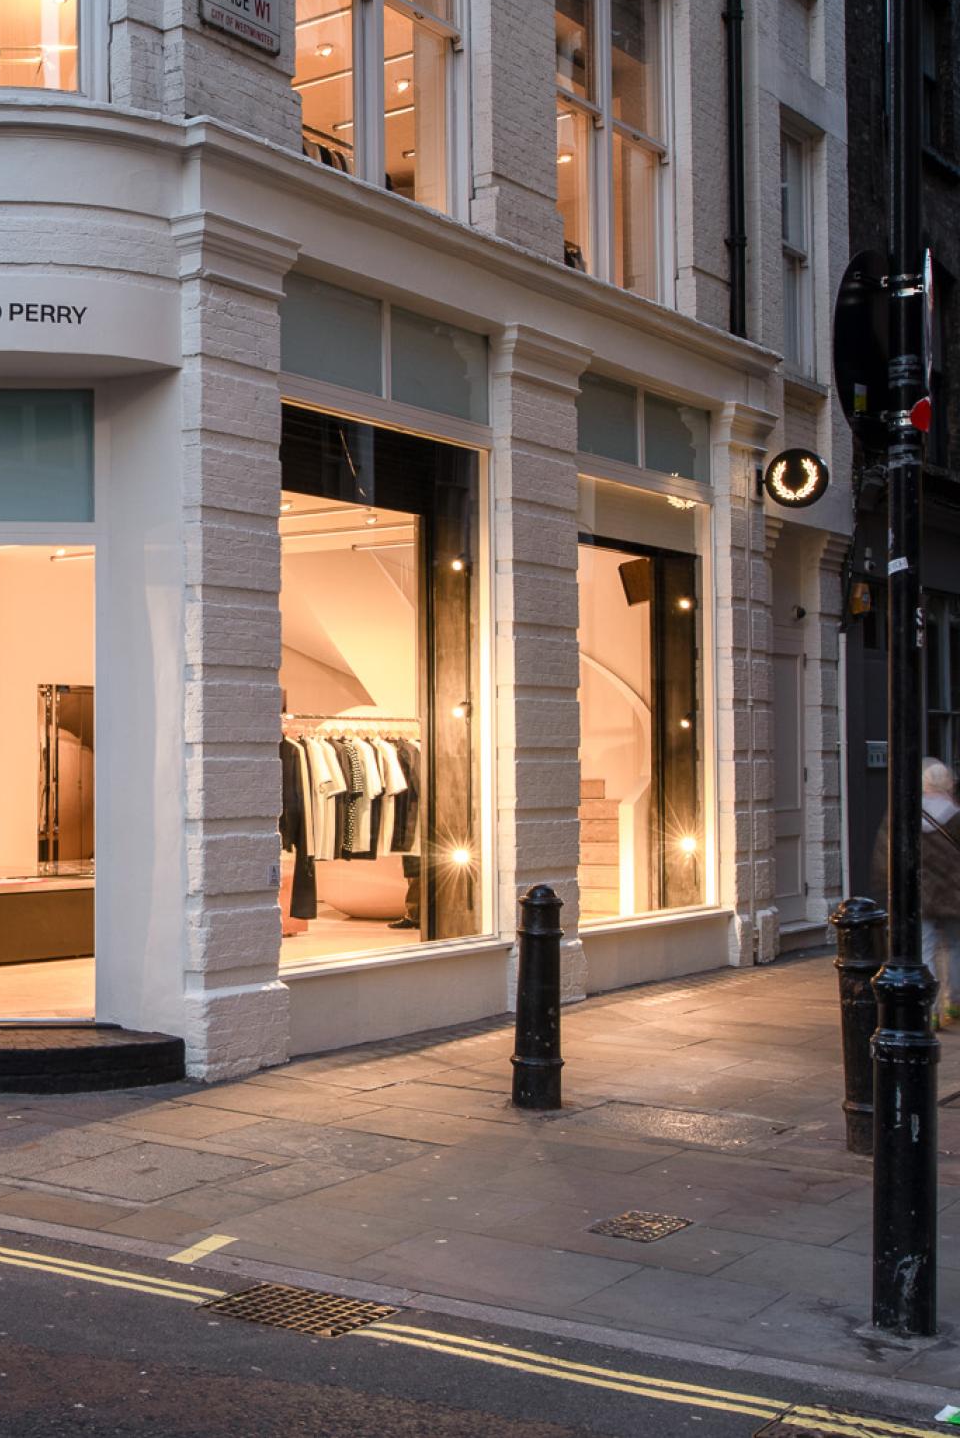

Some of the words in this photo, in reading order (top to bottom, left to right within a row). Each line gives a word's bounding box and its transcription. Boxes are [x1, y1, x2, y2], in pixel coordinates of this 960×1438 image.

[211, 8, 224, 21] CITY
[225, 15, 234, 26] OF
[234, 19, 274, 46] WESTMINSTER
[8, 302, 88, 325] PERRY
